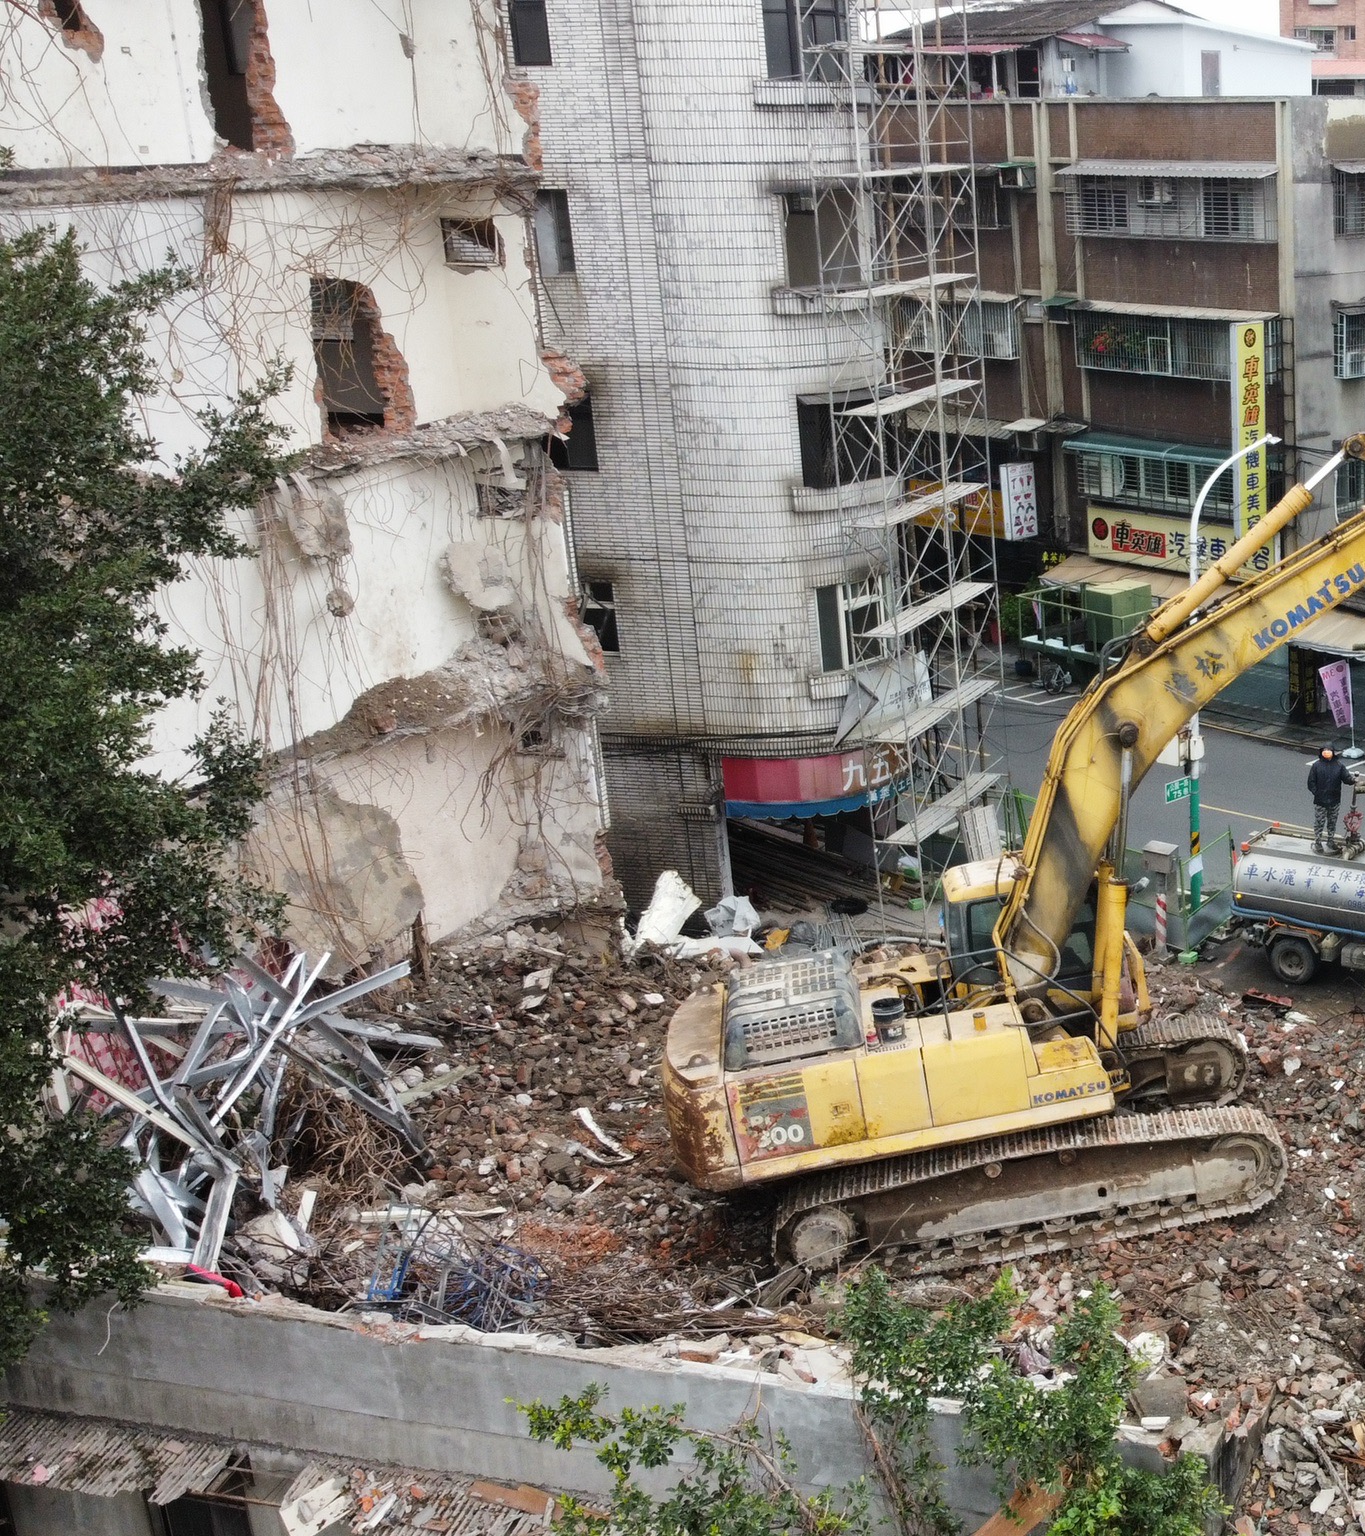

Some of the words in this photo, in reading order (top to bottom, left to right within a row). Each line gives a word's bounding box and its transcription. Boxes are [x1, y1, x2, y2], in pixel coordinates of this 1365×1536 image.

[1242, 355, 1261, 427] 車英雄
[1115, 519, 1163, 555] 車英雄
[1168, 531, 1270, 571] 汽機車容
[1033, 1080, 1107, 1104] KOMATSU
